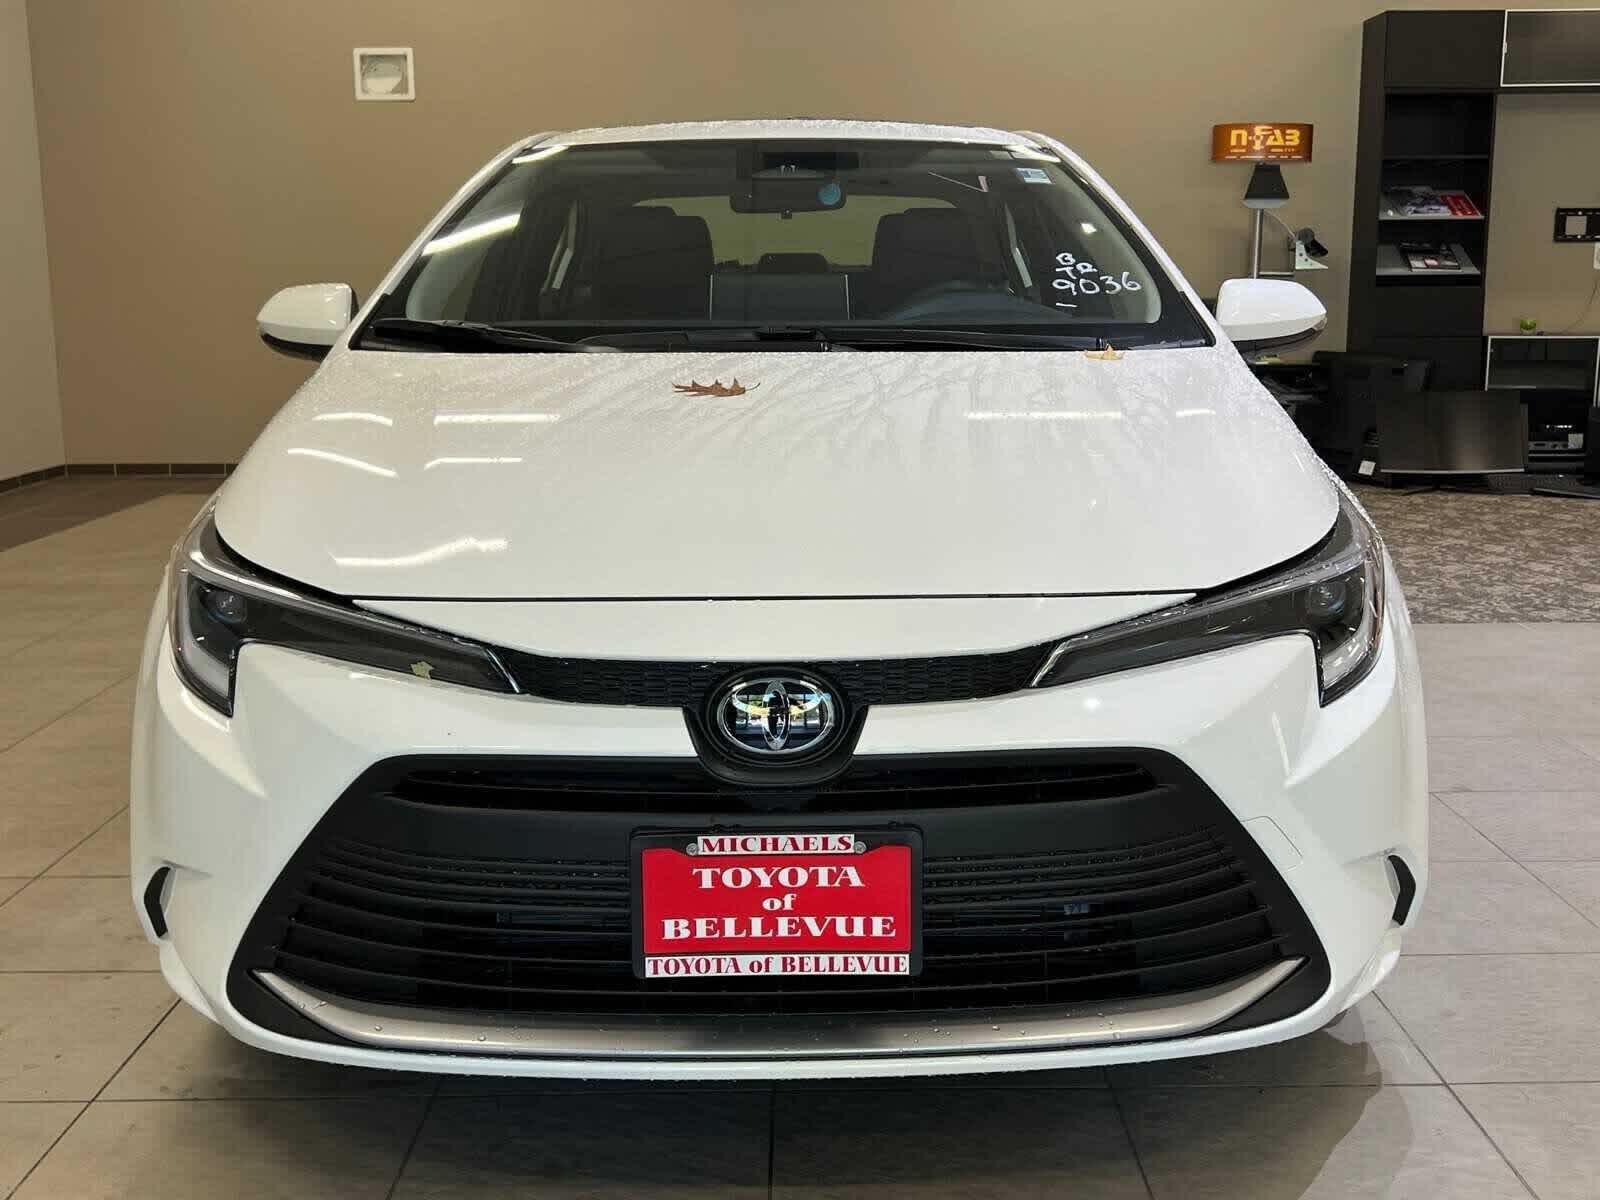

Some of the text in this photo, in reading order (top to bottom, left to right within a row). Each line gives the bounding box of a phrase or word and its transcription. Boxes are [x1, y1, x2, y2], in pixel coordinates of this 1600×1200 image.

[1052, 271, 1142, 296] 9036
[701, 836, 852, 853] MICHAELS
[692, 866, 865, 888] TOYOTA
[762, 893, 797, 911] of
[661, 916, 897, 940] BELLEVUE
[647, 955, 908, 976] TOYOTA of BELLEVUE
